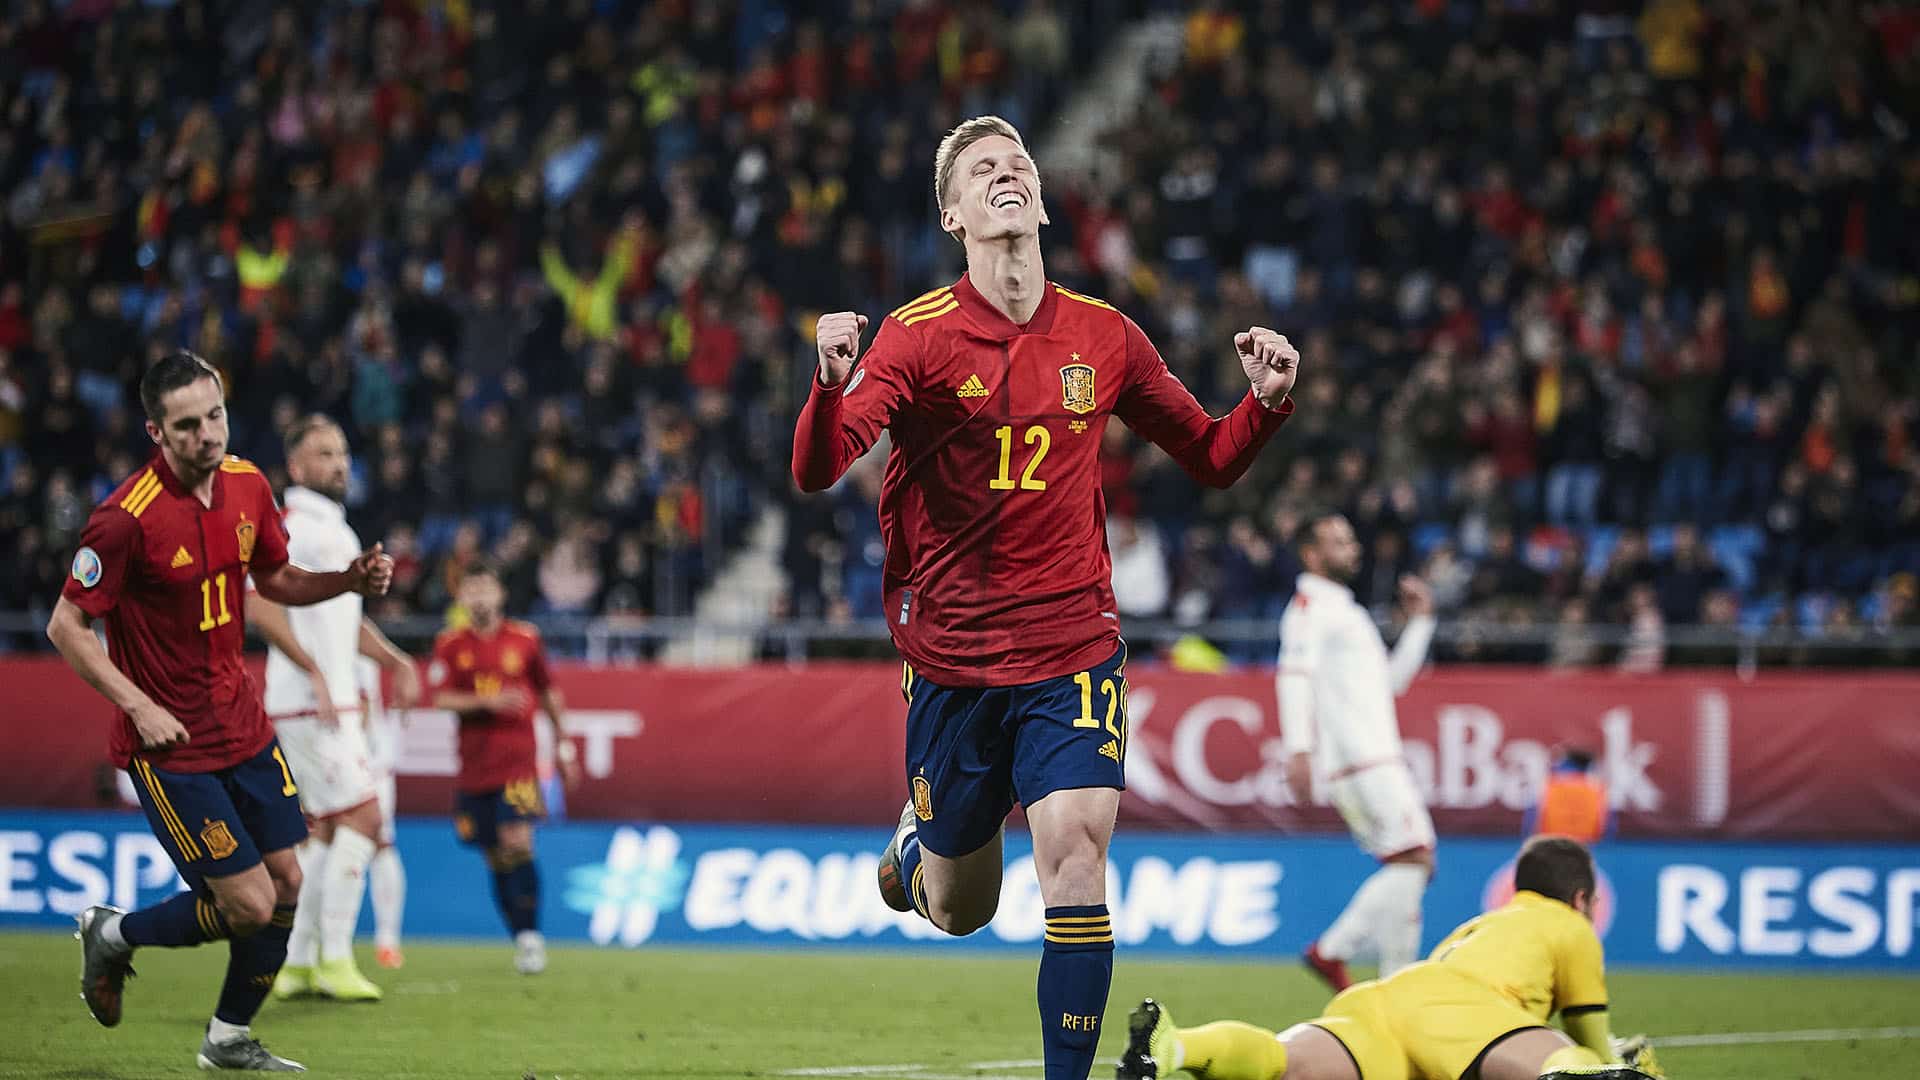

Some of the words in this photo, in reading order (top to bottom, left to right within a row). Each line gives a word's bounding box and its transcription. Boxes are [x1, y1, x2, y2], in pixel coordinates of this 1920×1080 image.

[956, 388, 990, 398] adidas
[989, 425, 1051, 491] 12
[199, 573, 232, 632] 11
[1073, 671, 1121, 740] 12
[0, 829, 192, 916] ESP
[1062, 1012, 1098, 1032] RFEF
